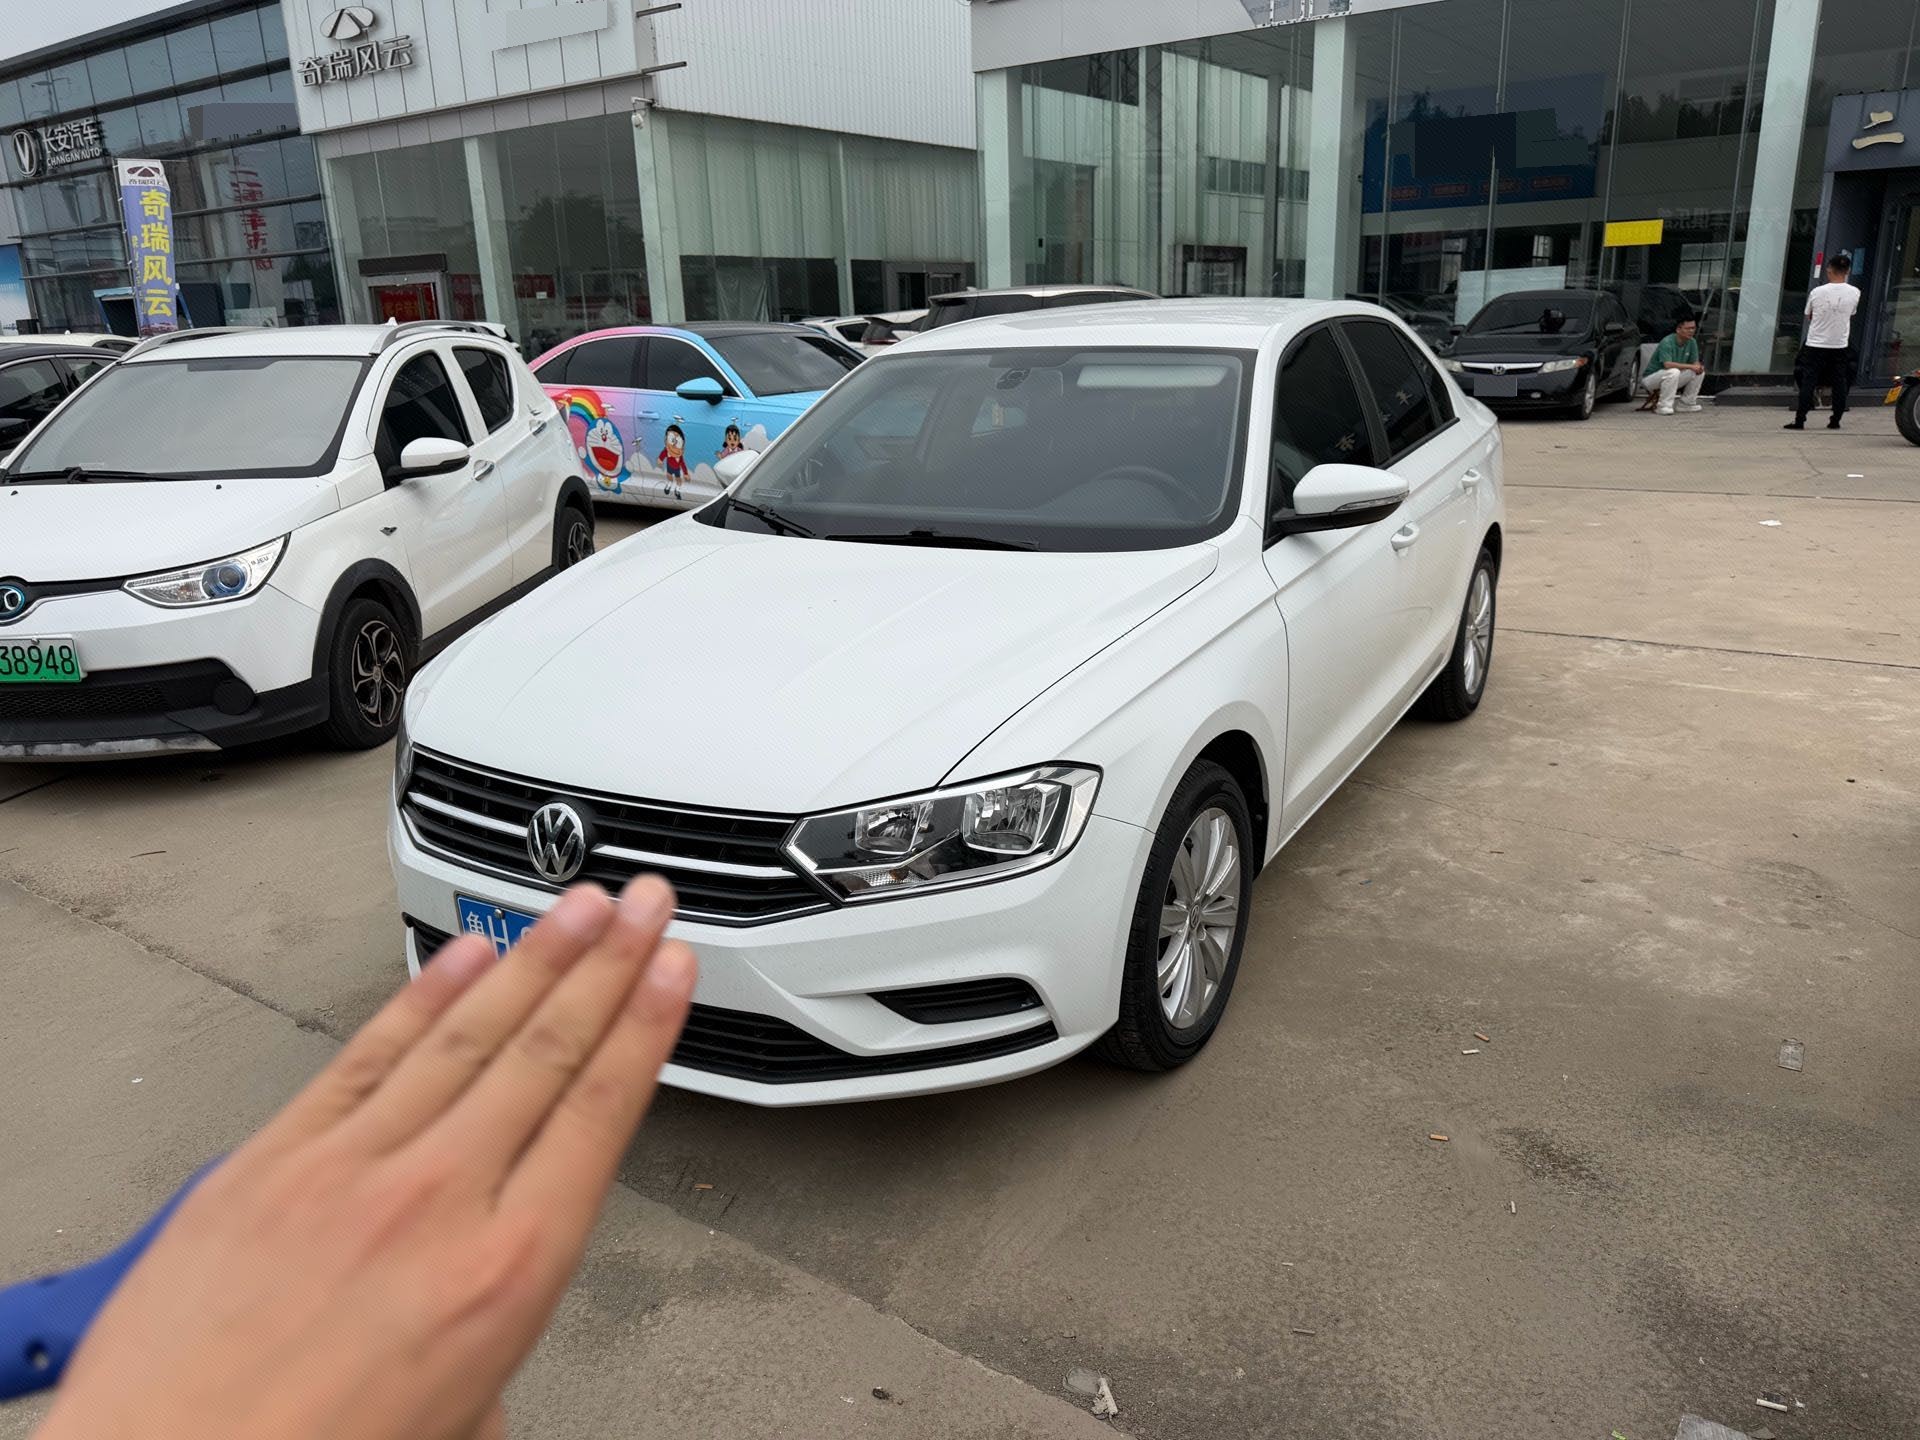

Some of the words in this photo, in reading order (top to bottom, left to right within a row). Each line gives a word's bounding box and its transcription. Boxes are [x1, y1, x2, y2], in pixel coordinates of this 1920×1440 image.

[298, 35, 412, 87] 奇瑞风云
[43, 118, 99, 154] 长安汽车
[1852, 111, 1904, 149] 二
[47, 151, 80, 167] CHANGAN
[80, 146, 101, 160] AUTO
[140, 189, 173, 317] 奇瑞风云
[0, 645, 76, 675] 38948
